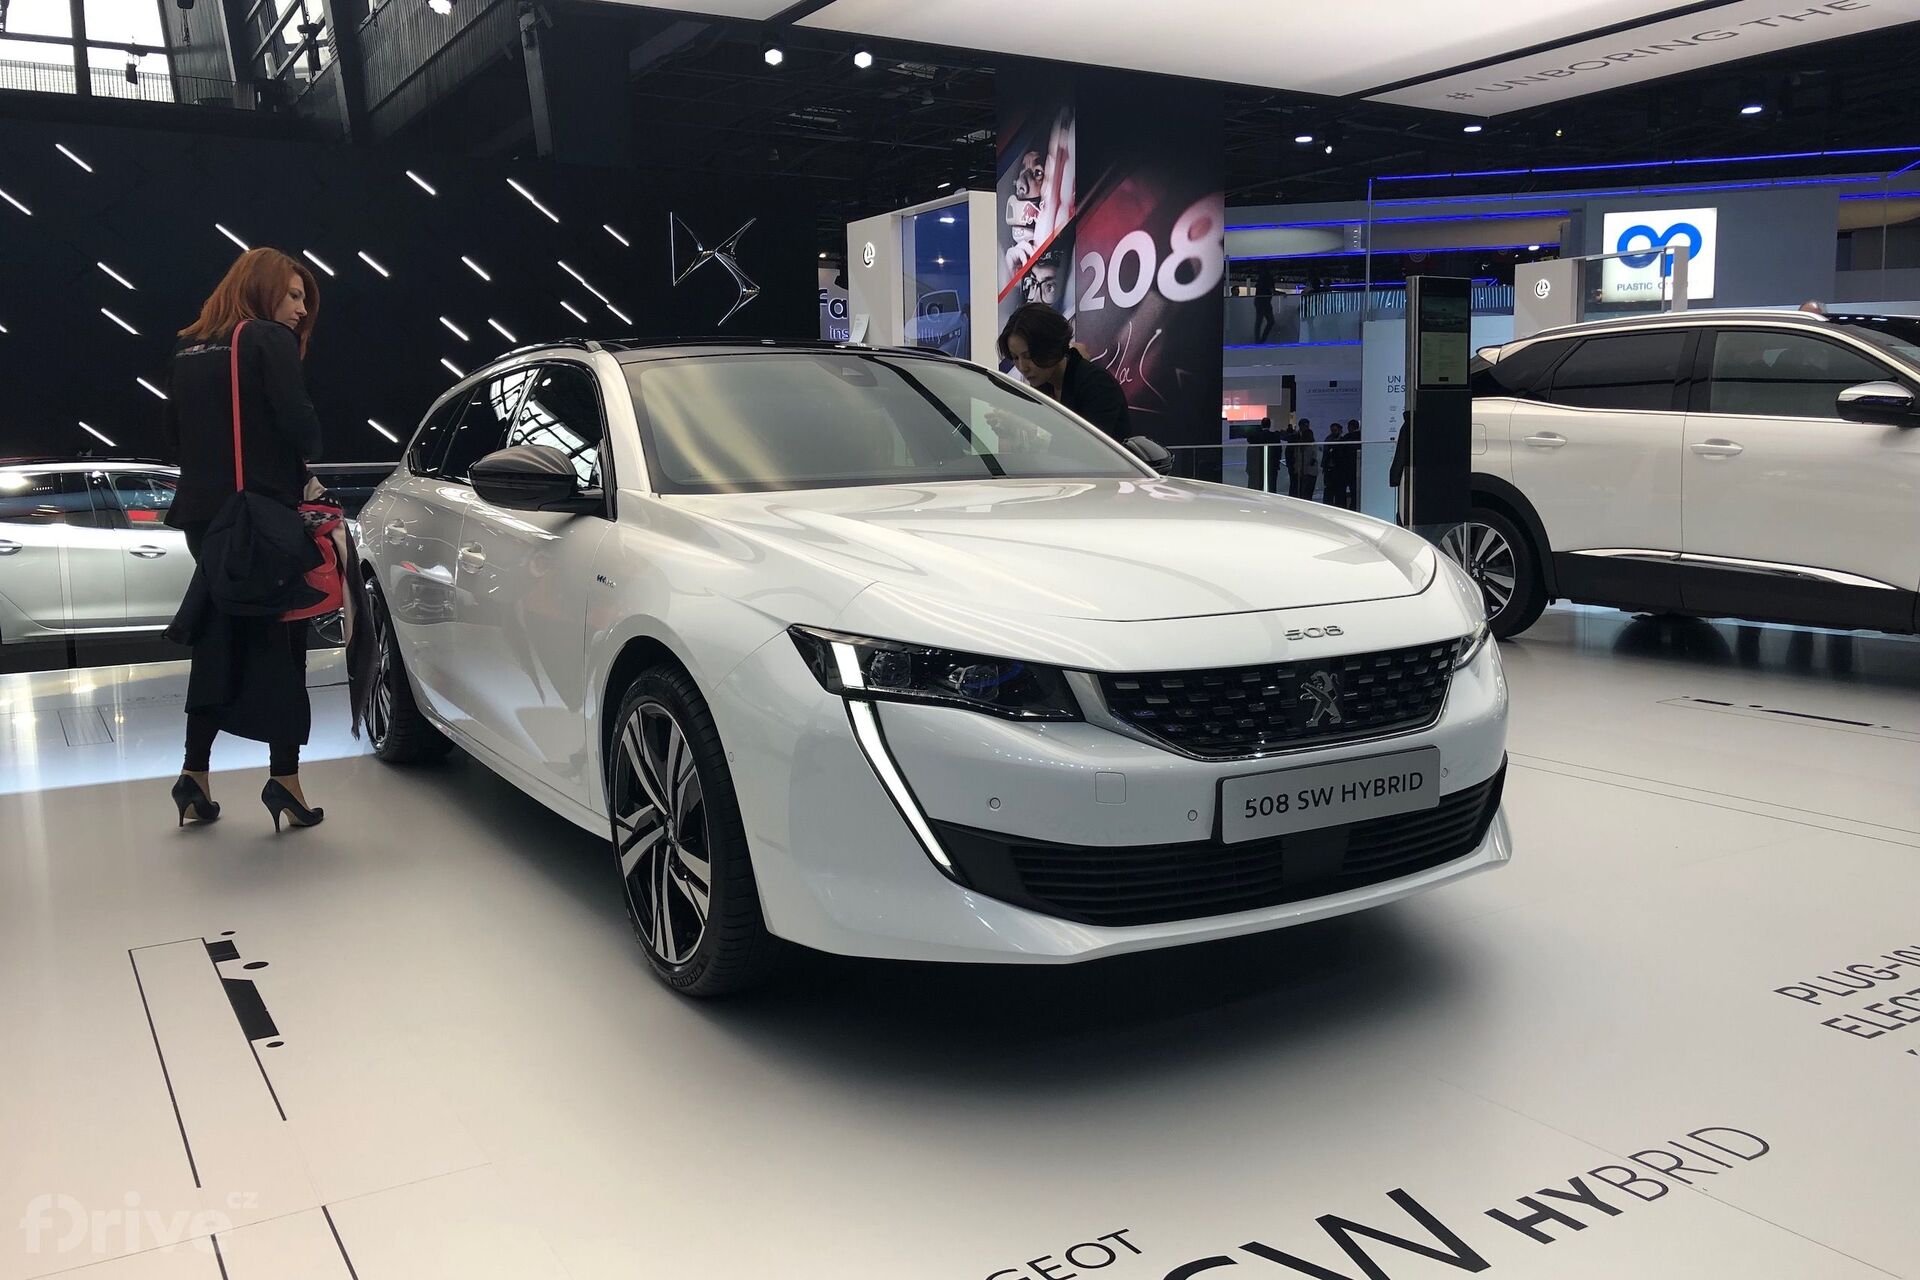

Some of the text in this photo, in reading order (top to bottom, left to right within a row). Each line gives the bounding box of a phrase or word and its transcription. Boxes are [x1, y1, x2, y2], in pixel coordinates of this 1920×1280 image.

[1740, 0, 1871, 28] THE
[1079, 190, 1224, 312] 208
[1616, 282, 1653, 291] PLASTIC
[1387, 375, 1401, 384] UN
[1284, 625, 1345, 641] 508
[1244, 771, 1424, 819] 508 SW HYBRID
[1483, 1126, 1771, 1245] HYBRID
